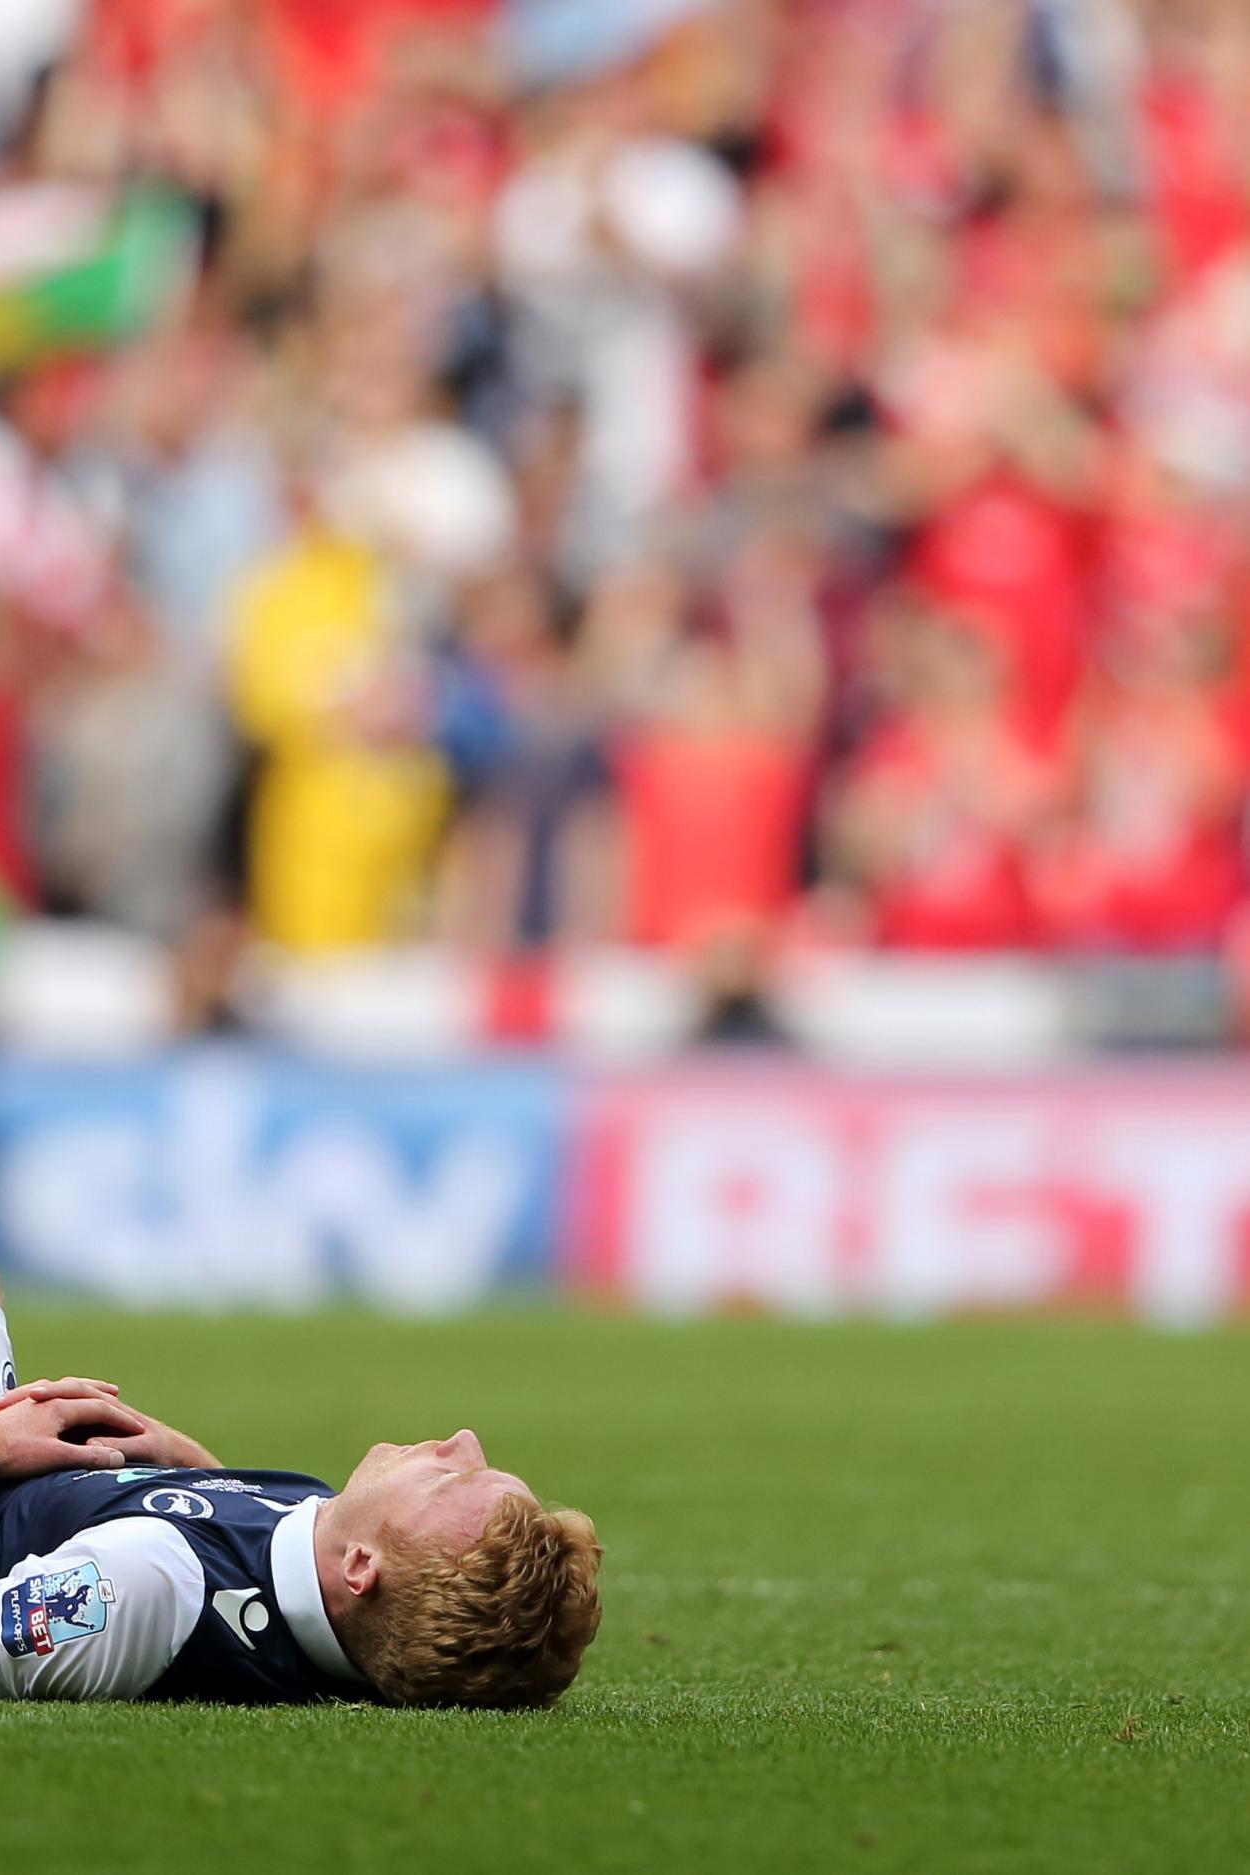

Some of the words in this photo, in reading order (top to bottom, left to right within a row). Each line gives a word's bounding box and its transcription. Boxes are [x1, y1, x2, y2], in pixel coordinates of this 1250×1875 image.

[27, 1577, 43, 1604] sky
[10, 1590, 28, 1652] PLAY-OFFS
[30, 1610, 51, 1649] BET
